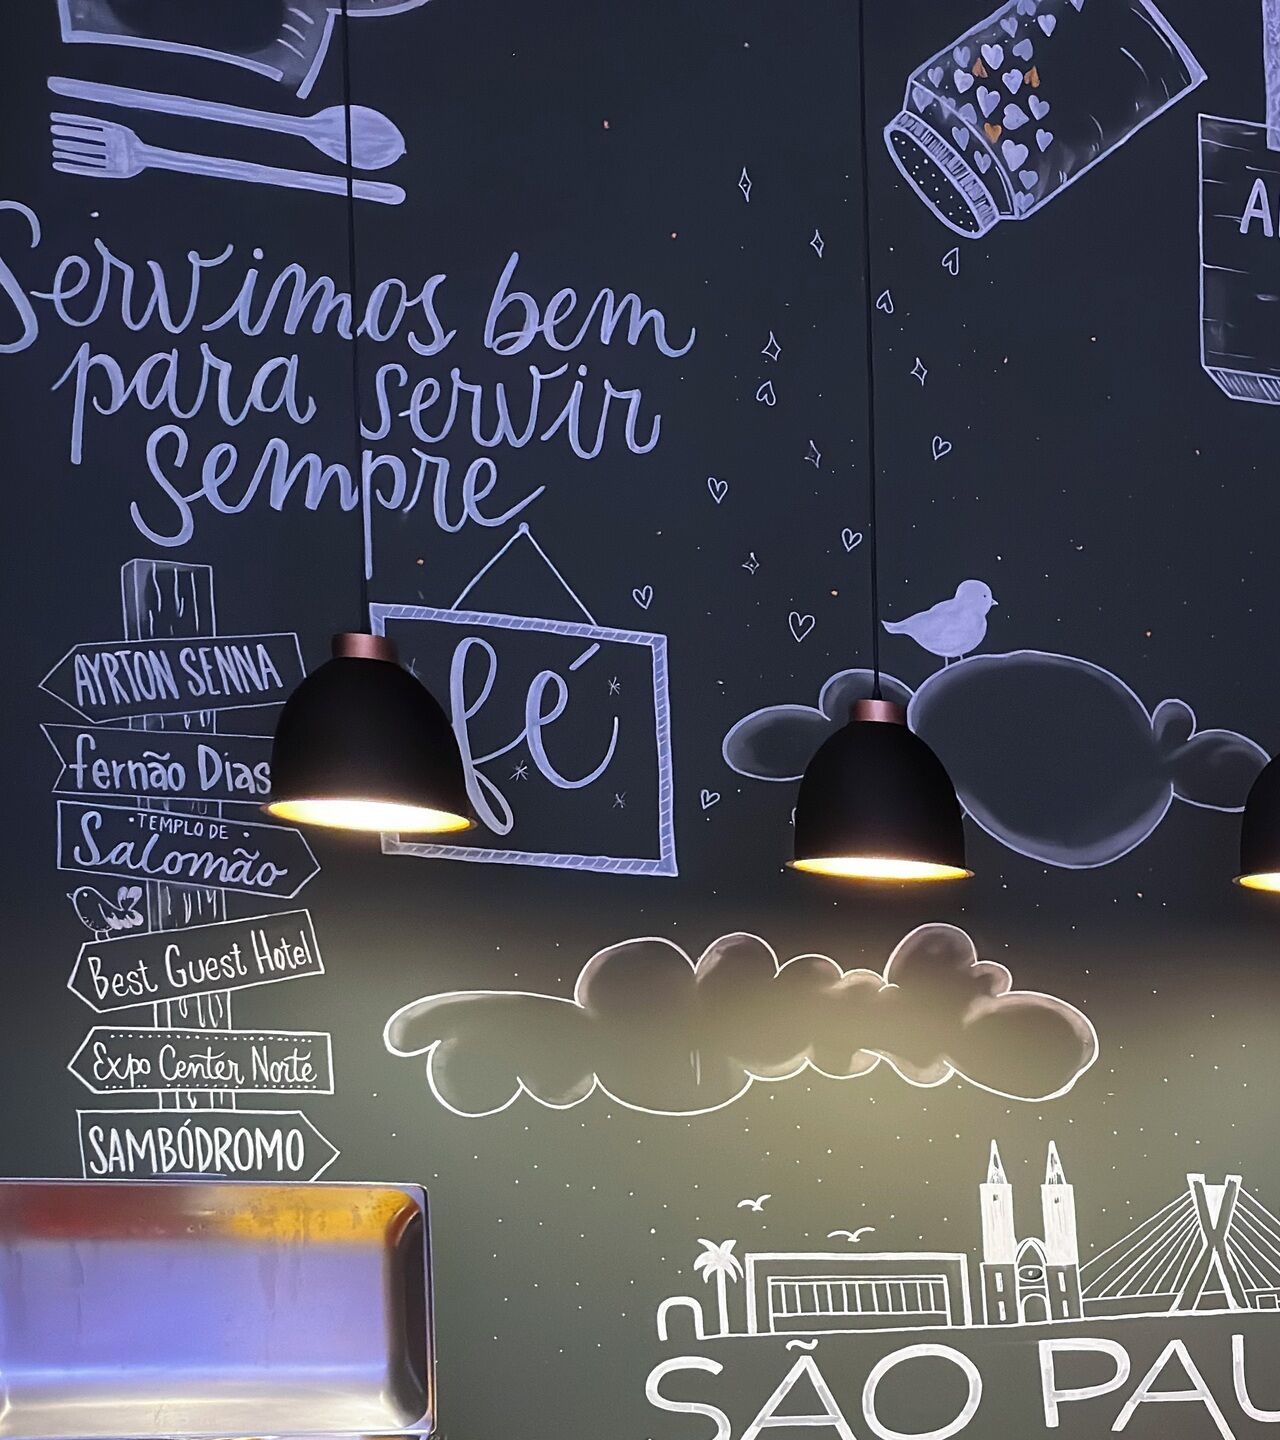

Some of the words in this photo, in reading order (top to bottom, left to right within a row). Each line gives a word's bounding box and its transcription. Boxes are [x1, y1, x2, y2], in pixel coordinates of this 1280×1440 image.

[0, 202, 456, 355] Servimos
[485, 252, 696, 358] bem
[52, 342, 316, 465] para
[73, 650, 178, 709] AYRTON
[179, 643, 284, 696] SENNA
[198, 745, 272, 796] Dias
[448, 637, 618, 835] fé
[73, 811, 288, 889] Salomão
[136, 812, 206, 838] TEMPLO
[208, 818, 230, 840] DE
[87, 953, 158, 1000] Best
[164, 943, 249, 987] Guest
[251, 925, 313, 975] Hotel
[93, 1042, 152, 1083] Expo
[158, 1045, 245, 1083] Center
[251, 1043, 318, 1084] Norte
[87, 1117, 304, 1175] SAMBÓDROMO
